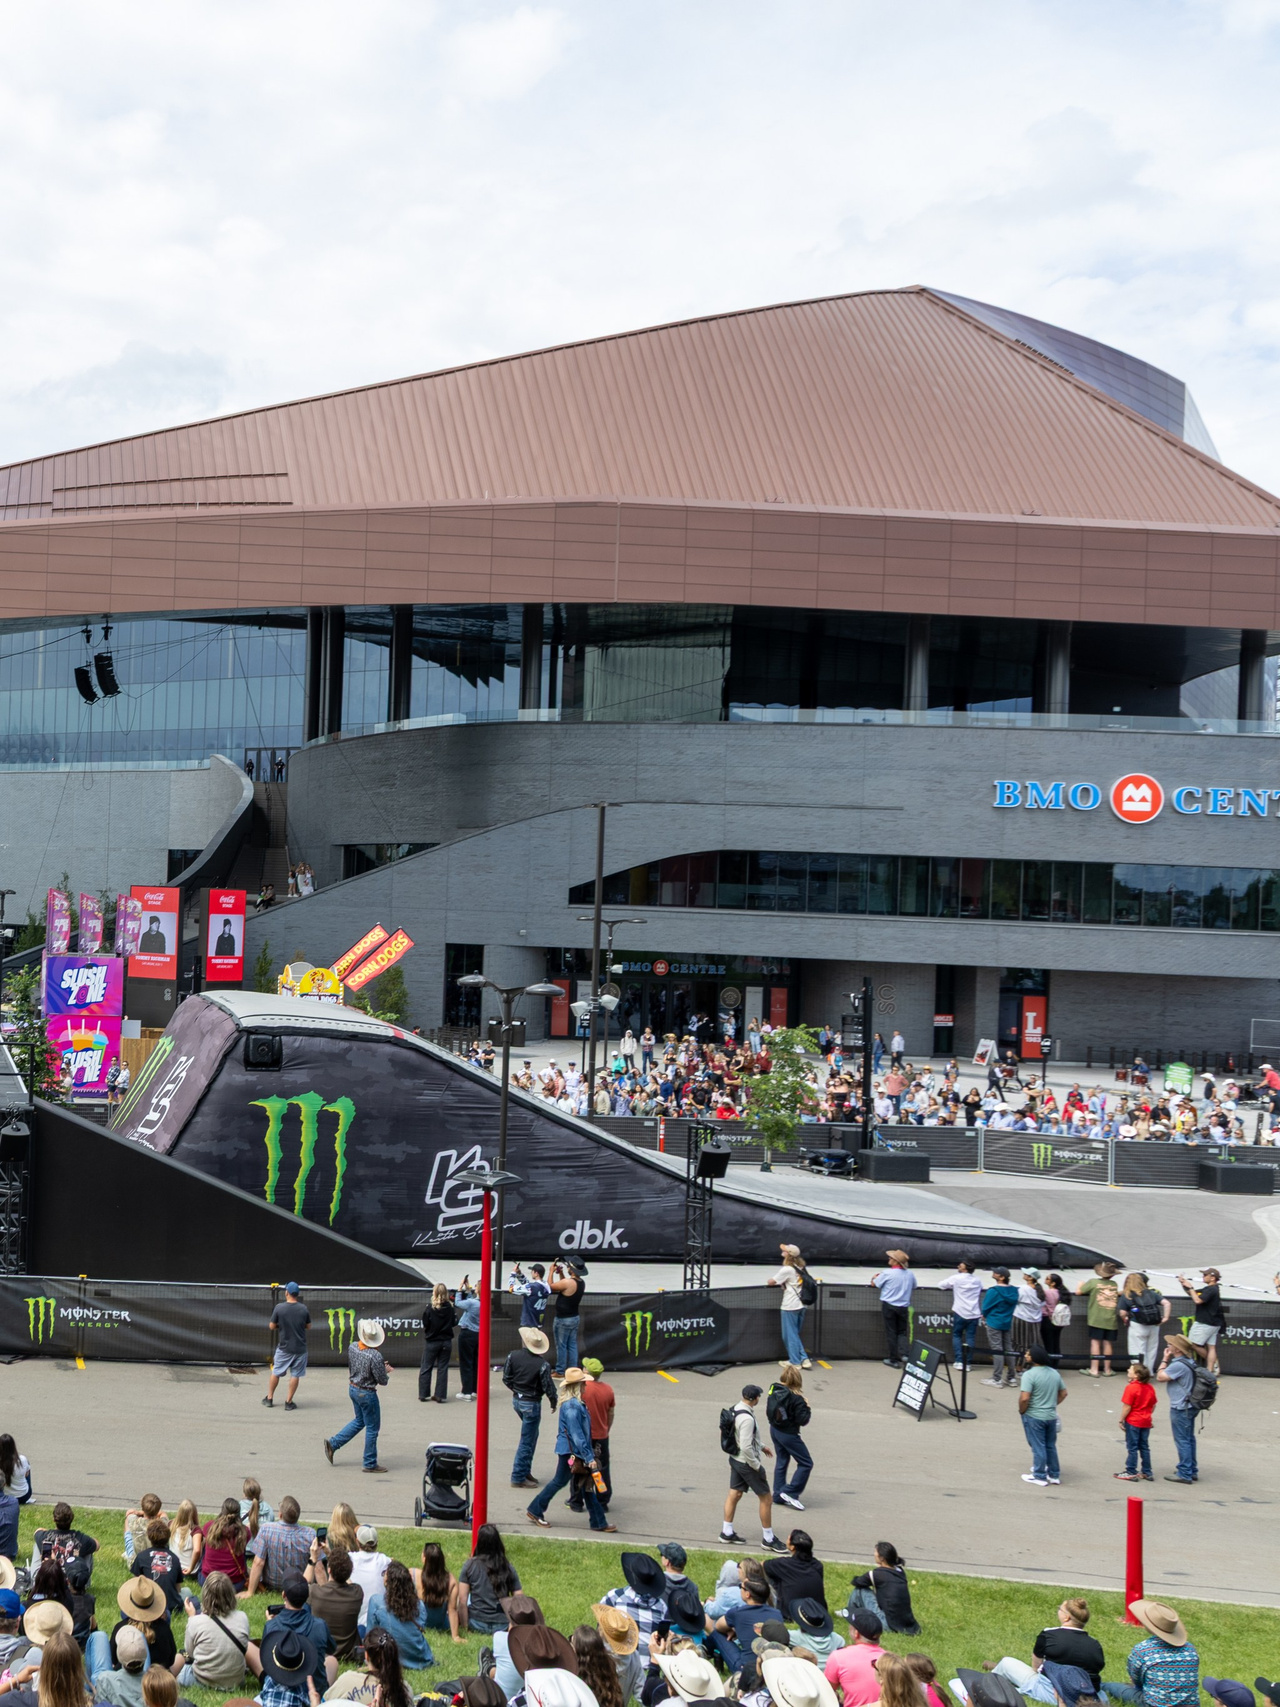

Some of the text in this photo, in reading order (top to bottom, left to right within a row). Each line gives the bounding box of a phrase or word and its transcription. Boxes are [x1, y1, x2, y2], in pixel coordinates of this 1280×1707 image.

[993, 780, 1102, 811] BMO
[337, 928, 385, 976] ORN DOGS
[348, 934, 409, 986] CORN DOGS
[60, 965, 108, 989] SLUSH
[621, 961, 726, 975] BMO CENTRE
[67, 982, 107, 1006] ZONE
[1025, 1012, 1042, 1033] L
[62, 1049, 102, 1076] SLUSH
[558, 1219, 629, 1250] dbk.
[60, 1306, 132, 1322] MONSTER
[656, 1317, 716, 1332] MONSTER
[69, 1321, 119, 1329] ENERGY
[664, 1330, 706, 1339] ENERGY
[1221, 1325, 1280, 1340] ONSTER
[1221, 1339, 1272, 1347] ENERGY
[902, 1373, 929, 1394] ATHLETE
